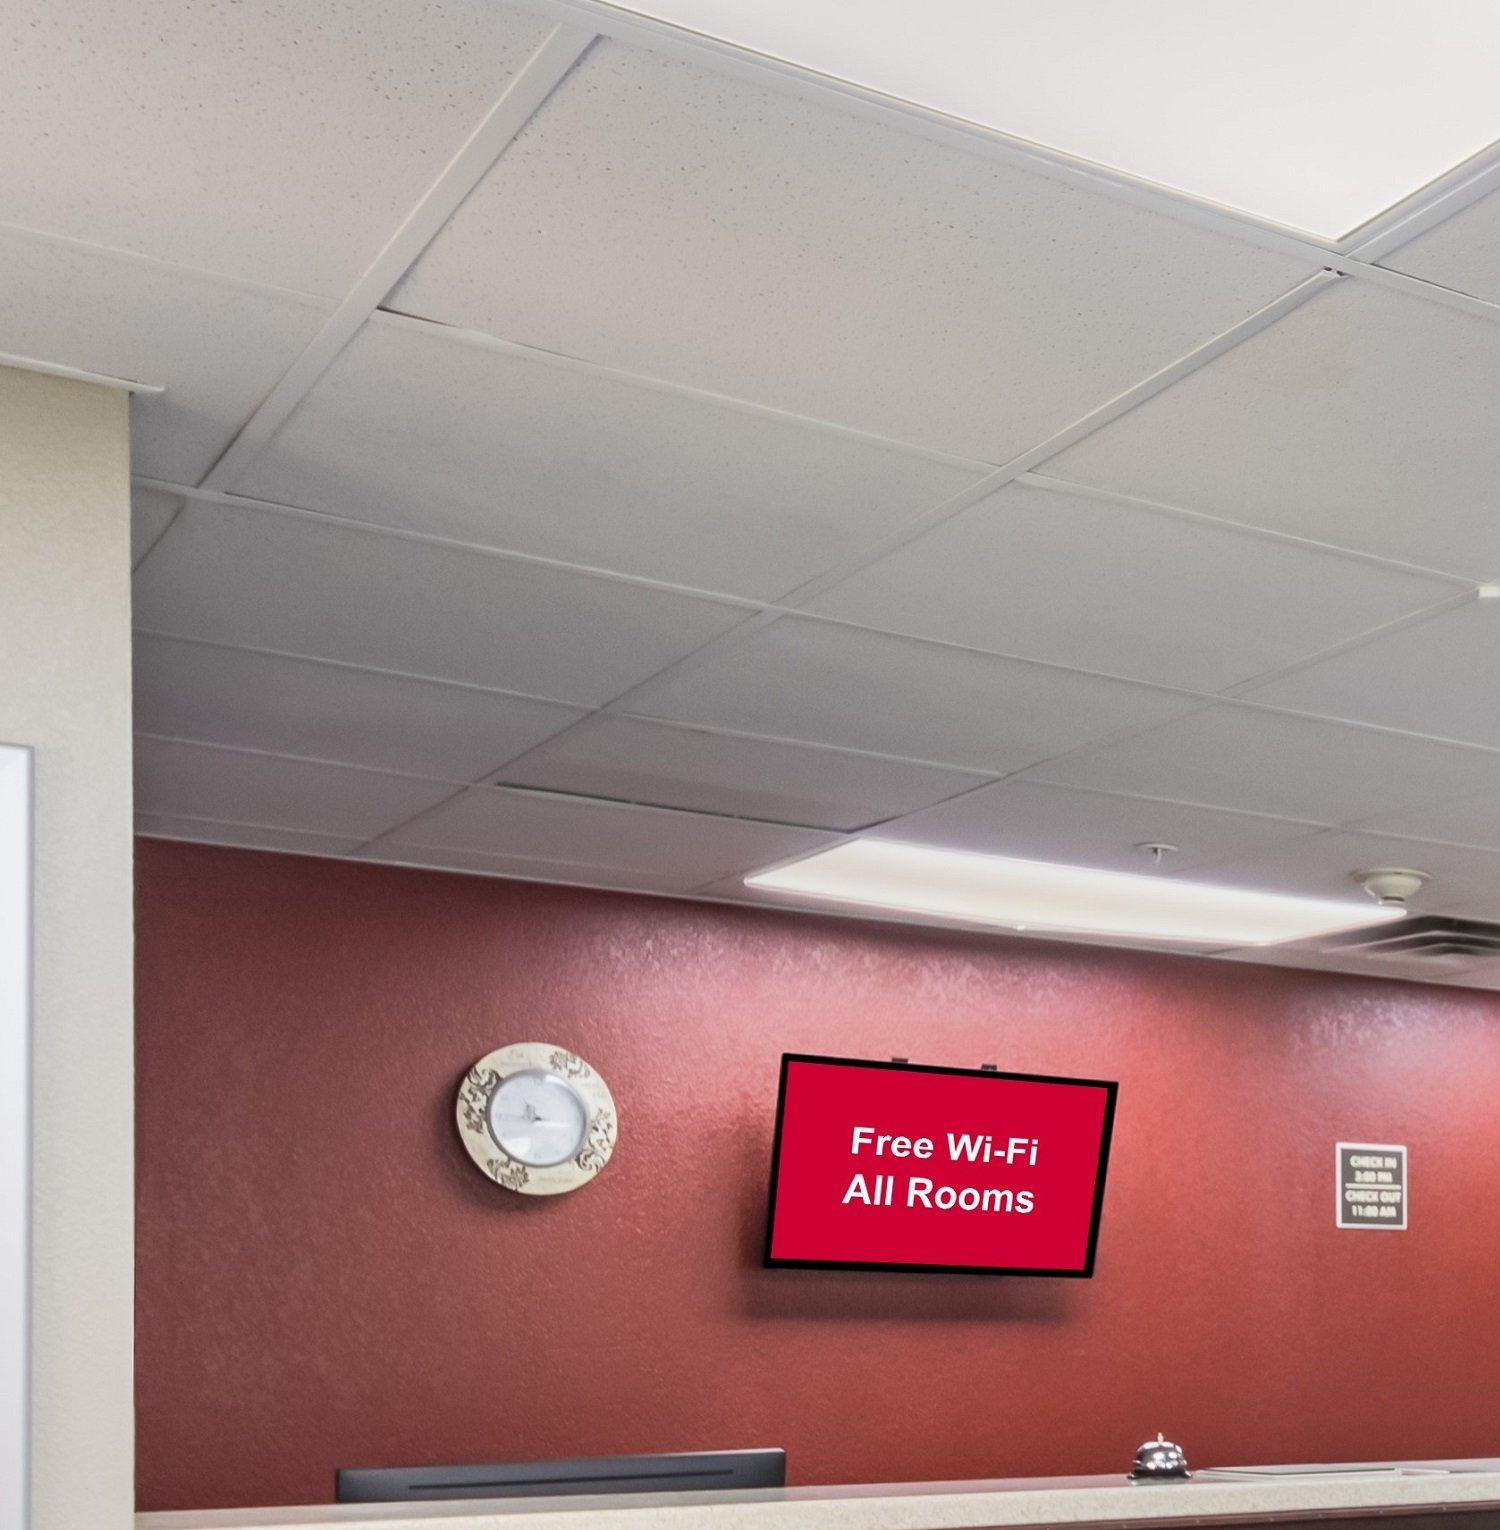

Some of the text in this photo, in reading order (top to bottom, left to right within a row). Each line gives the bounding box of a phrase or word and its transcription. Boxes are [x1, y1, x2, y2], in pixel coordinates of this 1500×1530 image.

[851, 1126, 1039, 1166] Free Wi-Fi
[1350, 1155, 1397, 1169] CHECK IN
[842, 1173, 1035, 1214] All Rooms
[1345, 1190, 1401, 1204] CHECK OUT
[1379, 1206, 1397, 1218] AM
